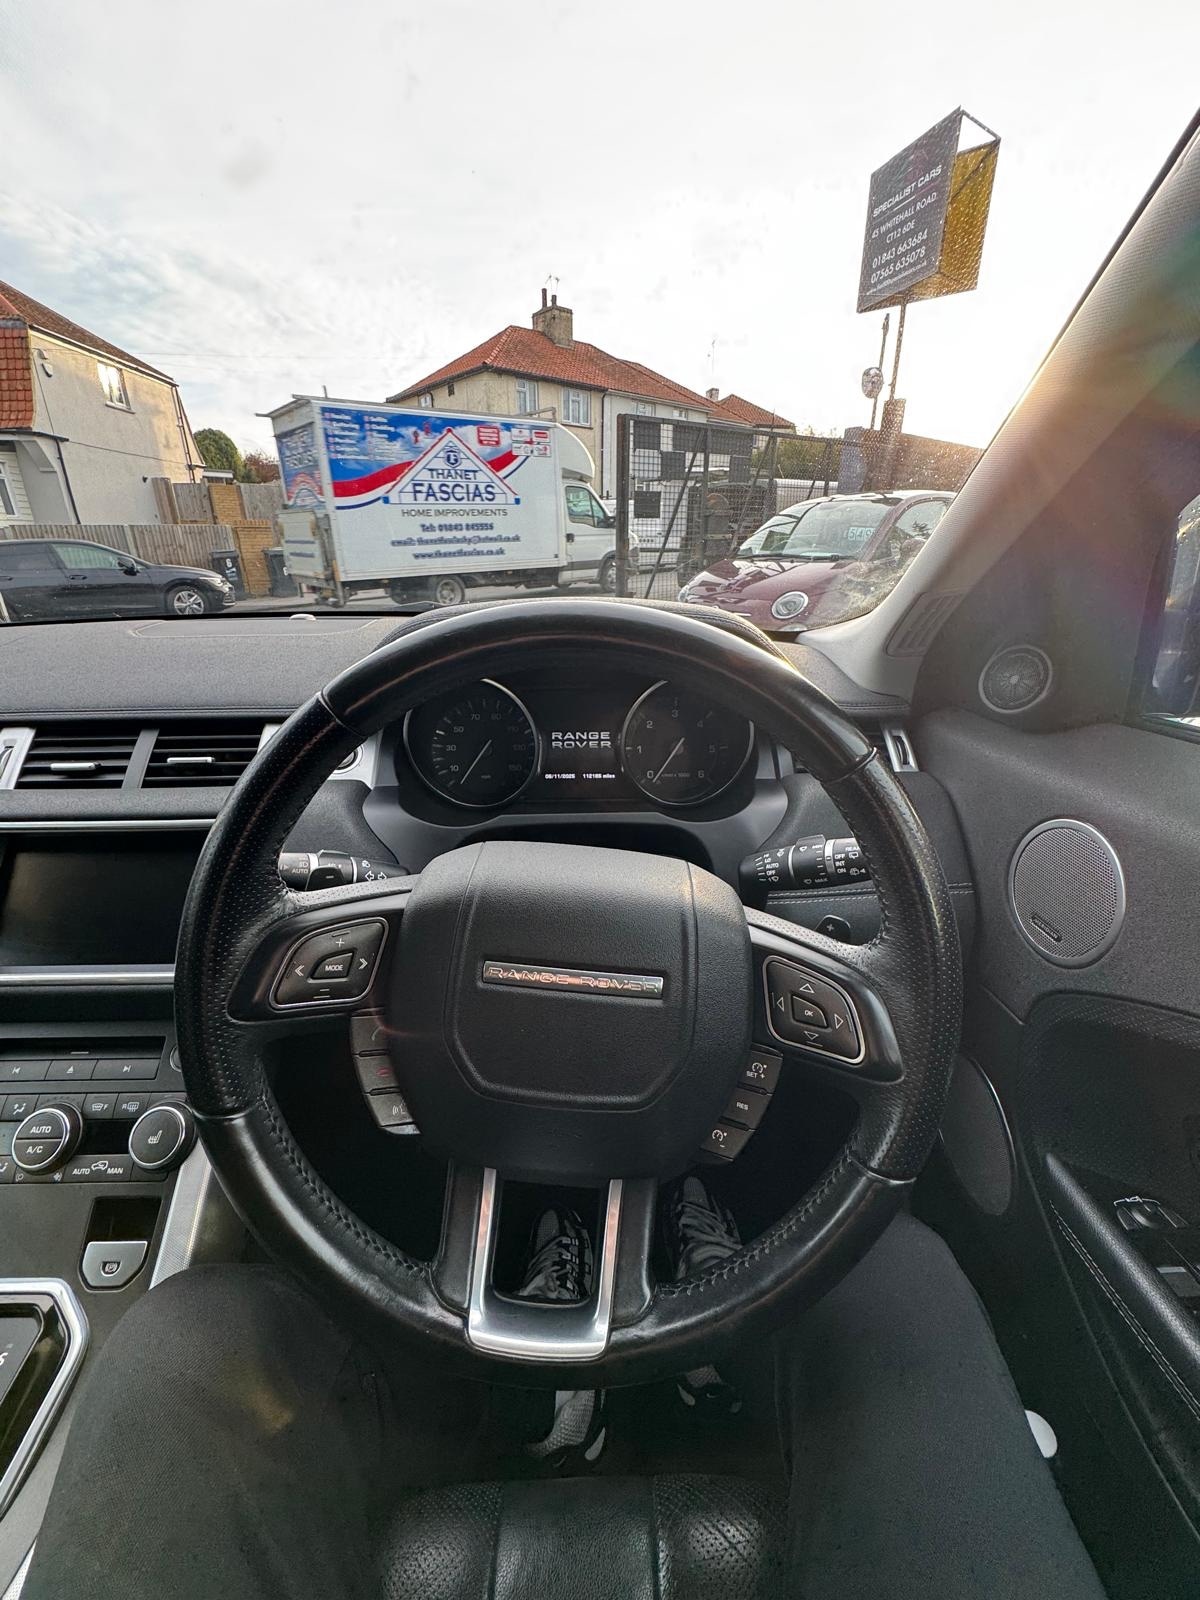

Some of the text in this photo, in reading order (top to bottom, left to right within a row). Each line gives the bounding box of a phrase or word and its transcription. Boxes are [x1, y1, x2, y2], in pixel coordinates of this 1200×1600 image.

[873, 164, 942, 217] SPECIALIST CARS
[880, 205, 915, 234] WHITEHALL
[916, 192, 937, 211] ROAD
[886, 219, 916, 244] CT12 6DE
[872, 228, 928, 269] 01843 663684
[870, 263, 894, 284] 07565
[895, 246, 926, 271] 635078
[428, 468, 478, 480] THANET
[412, 483, 496, 502] FASCIAS
[401, 508, 508, 517] HOME IMPROVEMENTS
[646, 720, 654, 729] 2
[453, 726, 465, 734] 50
[552, 732, 611, 740] RANGE
[552, 741, 612, 749] ROVER
[646, 769, 654, 778] 0
[325, 964, 344, 972] MODE
[486, 967, 658, 993] RANGE ROVER
[804, 1009, 814, 1017] OK
[746, 1070, 758, 1079] SET
[736, 1101, 749, 1110] RES
[30, 1126, 52, 1134] AUTO
[26, 1145, 44, 1154] A/C
[72, 1167, 91, 1175] AUTO
